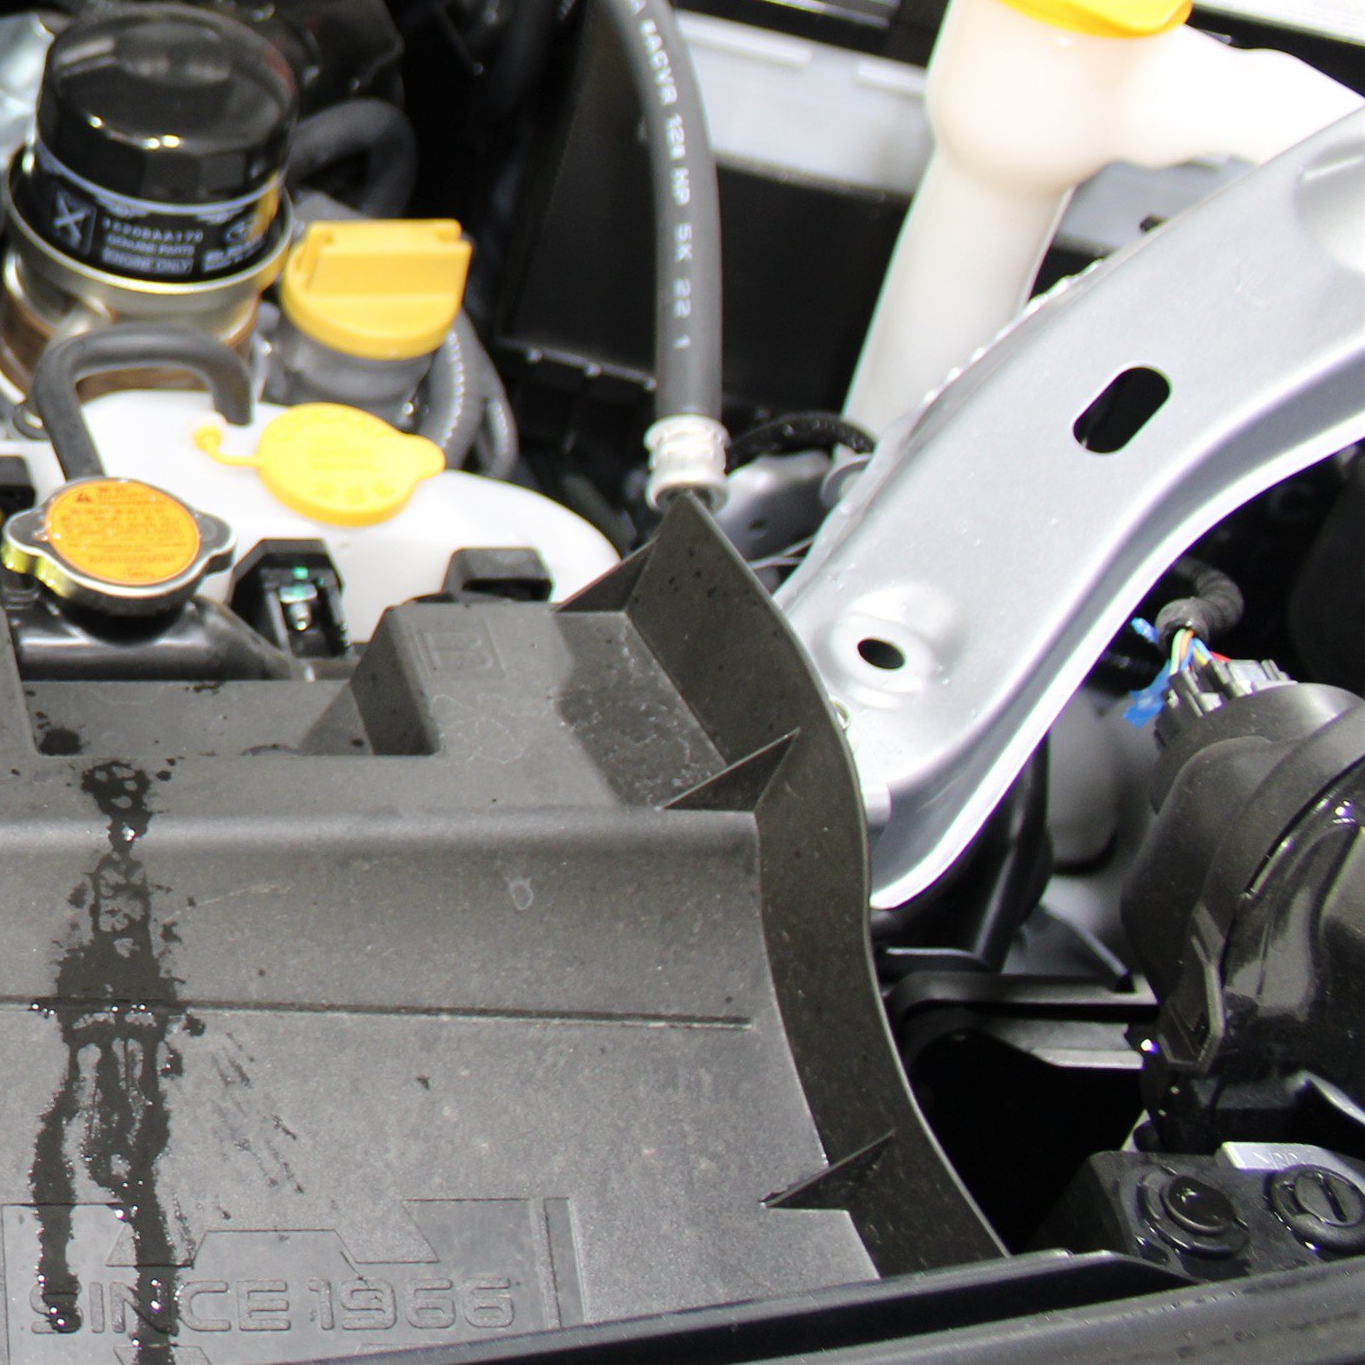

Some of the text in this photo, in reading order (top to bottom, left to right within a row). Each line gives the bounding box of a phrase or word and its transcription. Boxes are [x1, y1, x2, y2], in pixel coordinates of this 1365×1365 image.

[672, 169, 690, 206] HP
[676, 224, 693, 261] 5K
[675, 279, 692, 317] 22
[674, 334, 691, 349] 1
[30, 1275, 516, 1335] SINCE 1966
